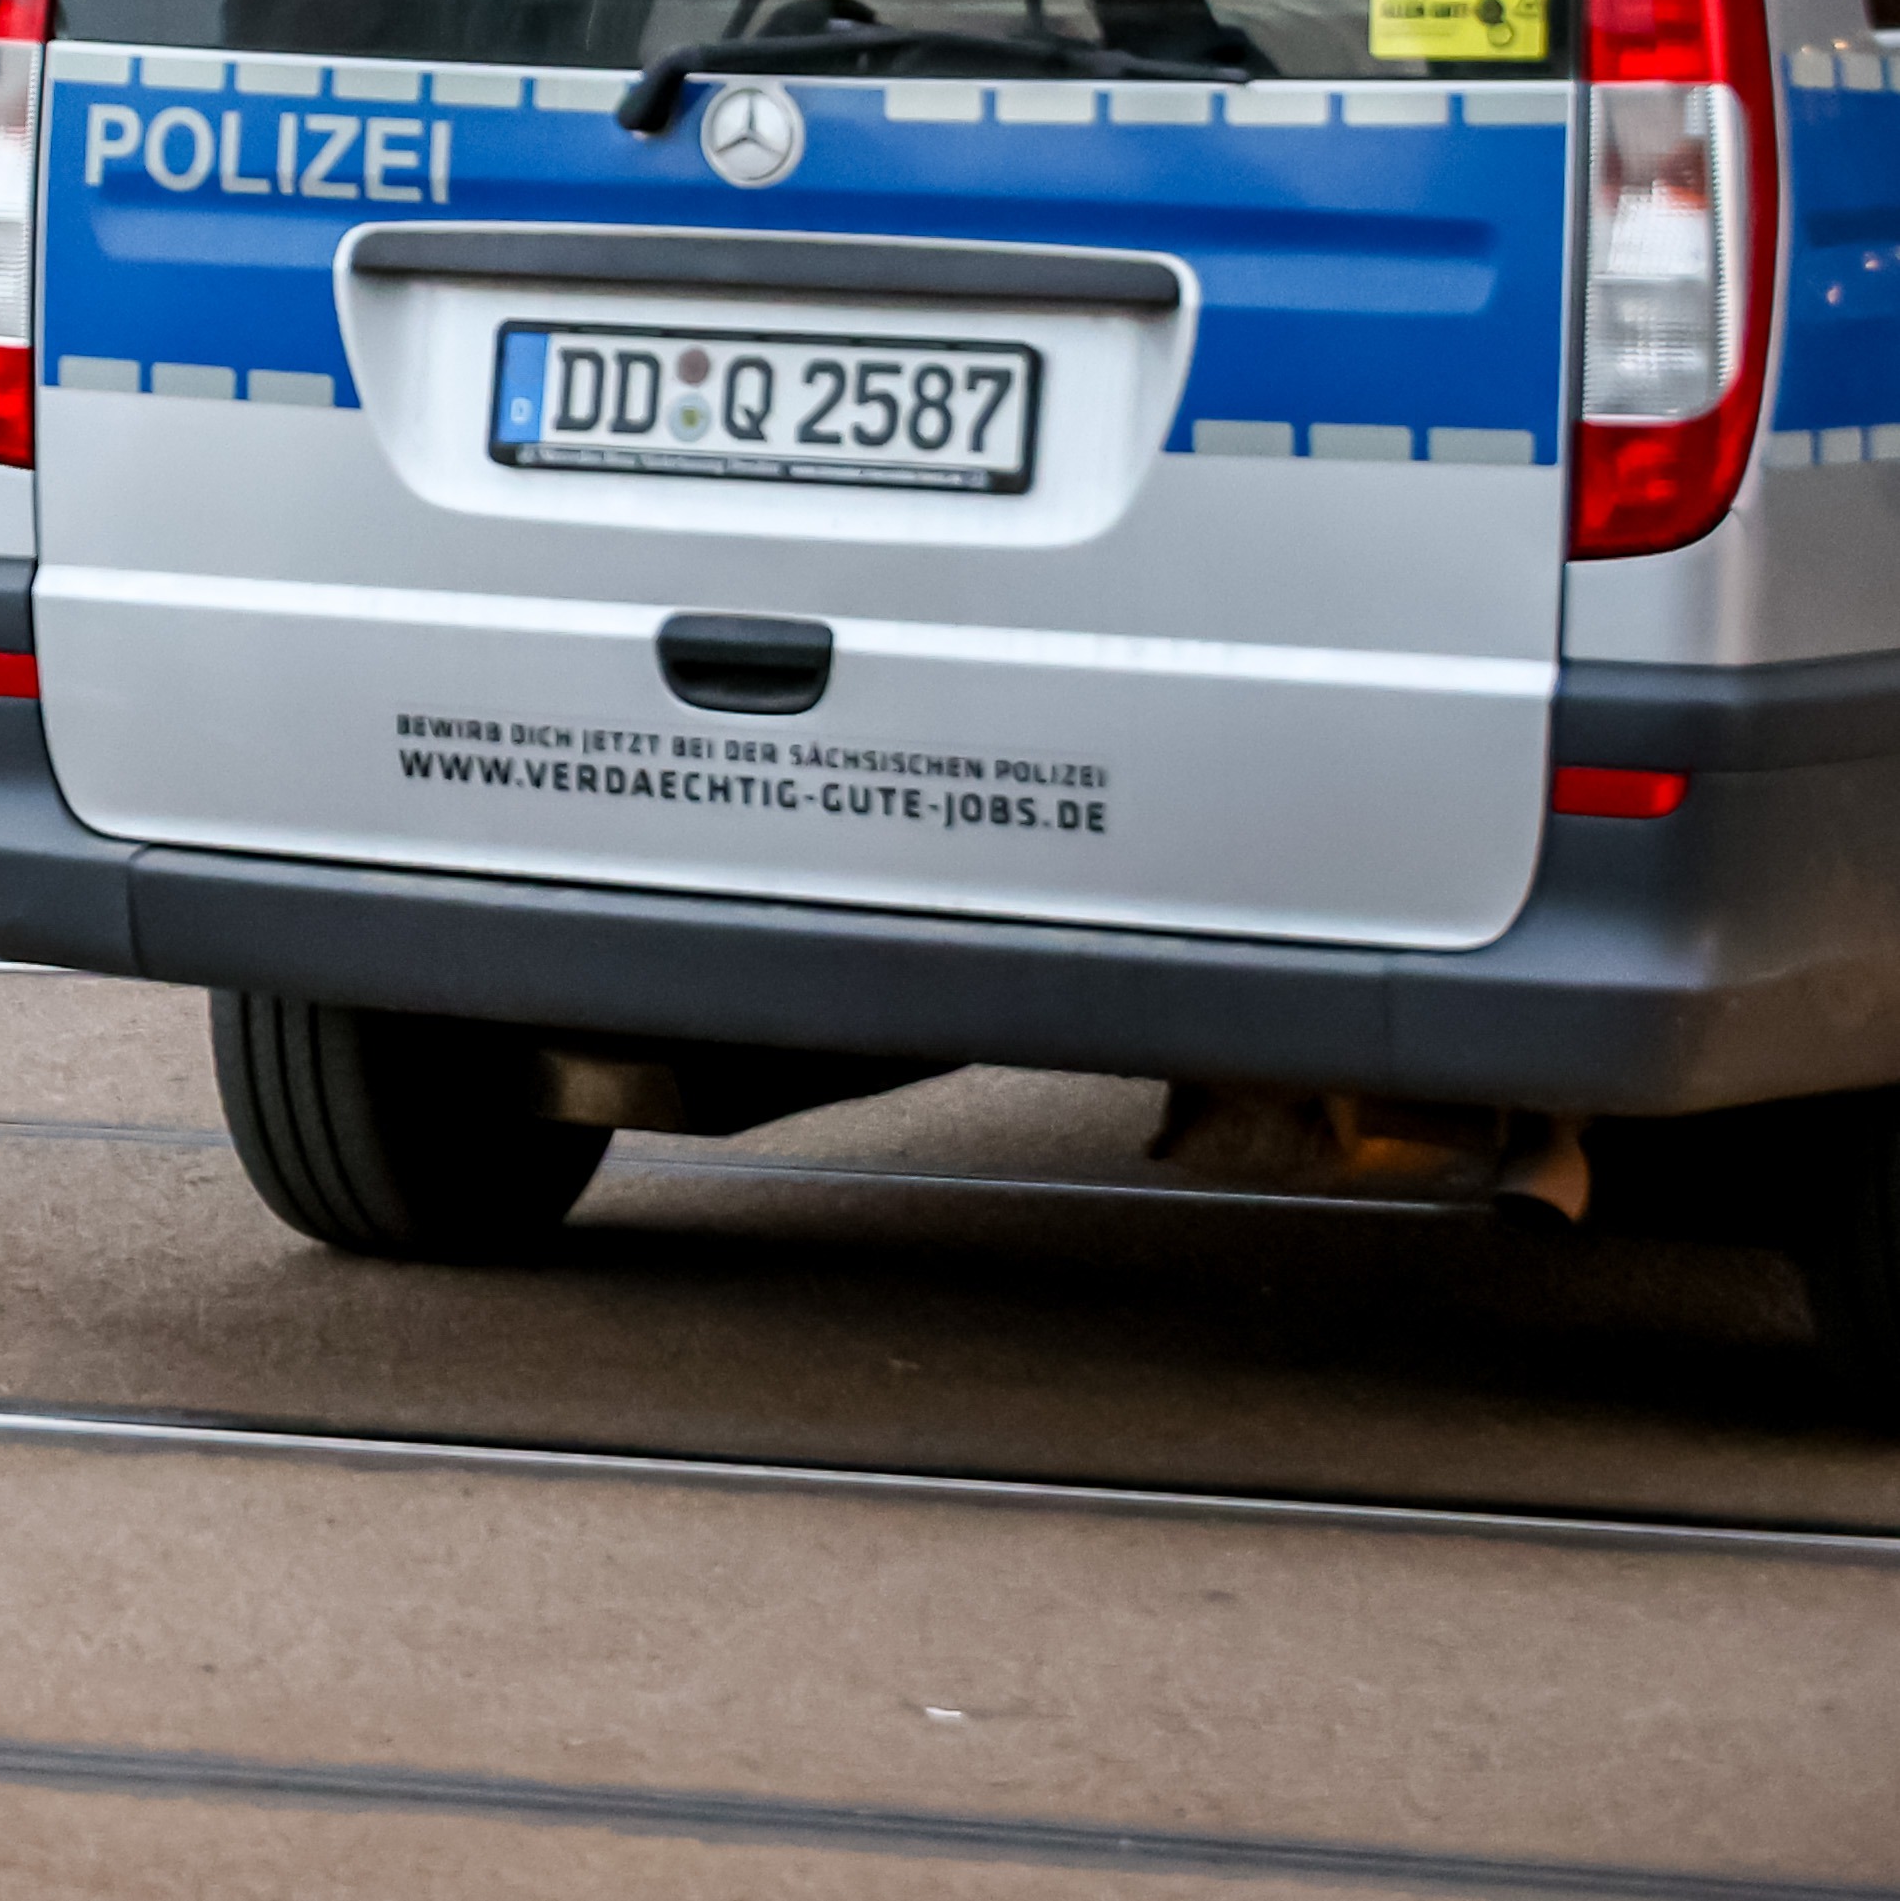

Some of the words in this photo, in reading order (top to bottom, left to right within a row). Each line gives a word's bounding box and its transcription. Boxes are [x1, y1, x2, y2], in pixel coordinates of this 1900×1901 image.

[84, 103, 451, 205] POLIZEI
[556, 347, 661, 434] DD
[724, 356, 773, 443] Q
[796, 358, 1012, 453] 2587
[397, 713, 500, 743] BEWIRB
[511, 722, 573, 748] DICH
[582, 728, 660, 755] JETZT
[671, 735, 714, 759] BEI
[725, 740, 778, 765] DER
[789, 741, 984, 780] SÄCHSISCHEN
[995, 759, 1108, 788] POLIZEI
[400, 748, 1106, 833] WWW.VERDAECHTIG-GUTE-JOBS.DE
